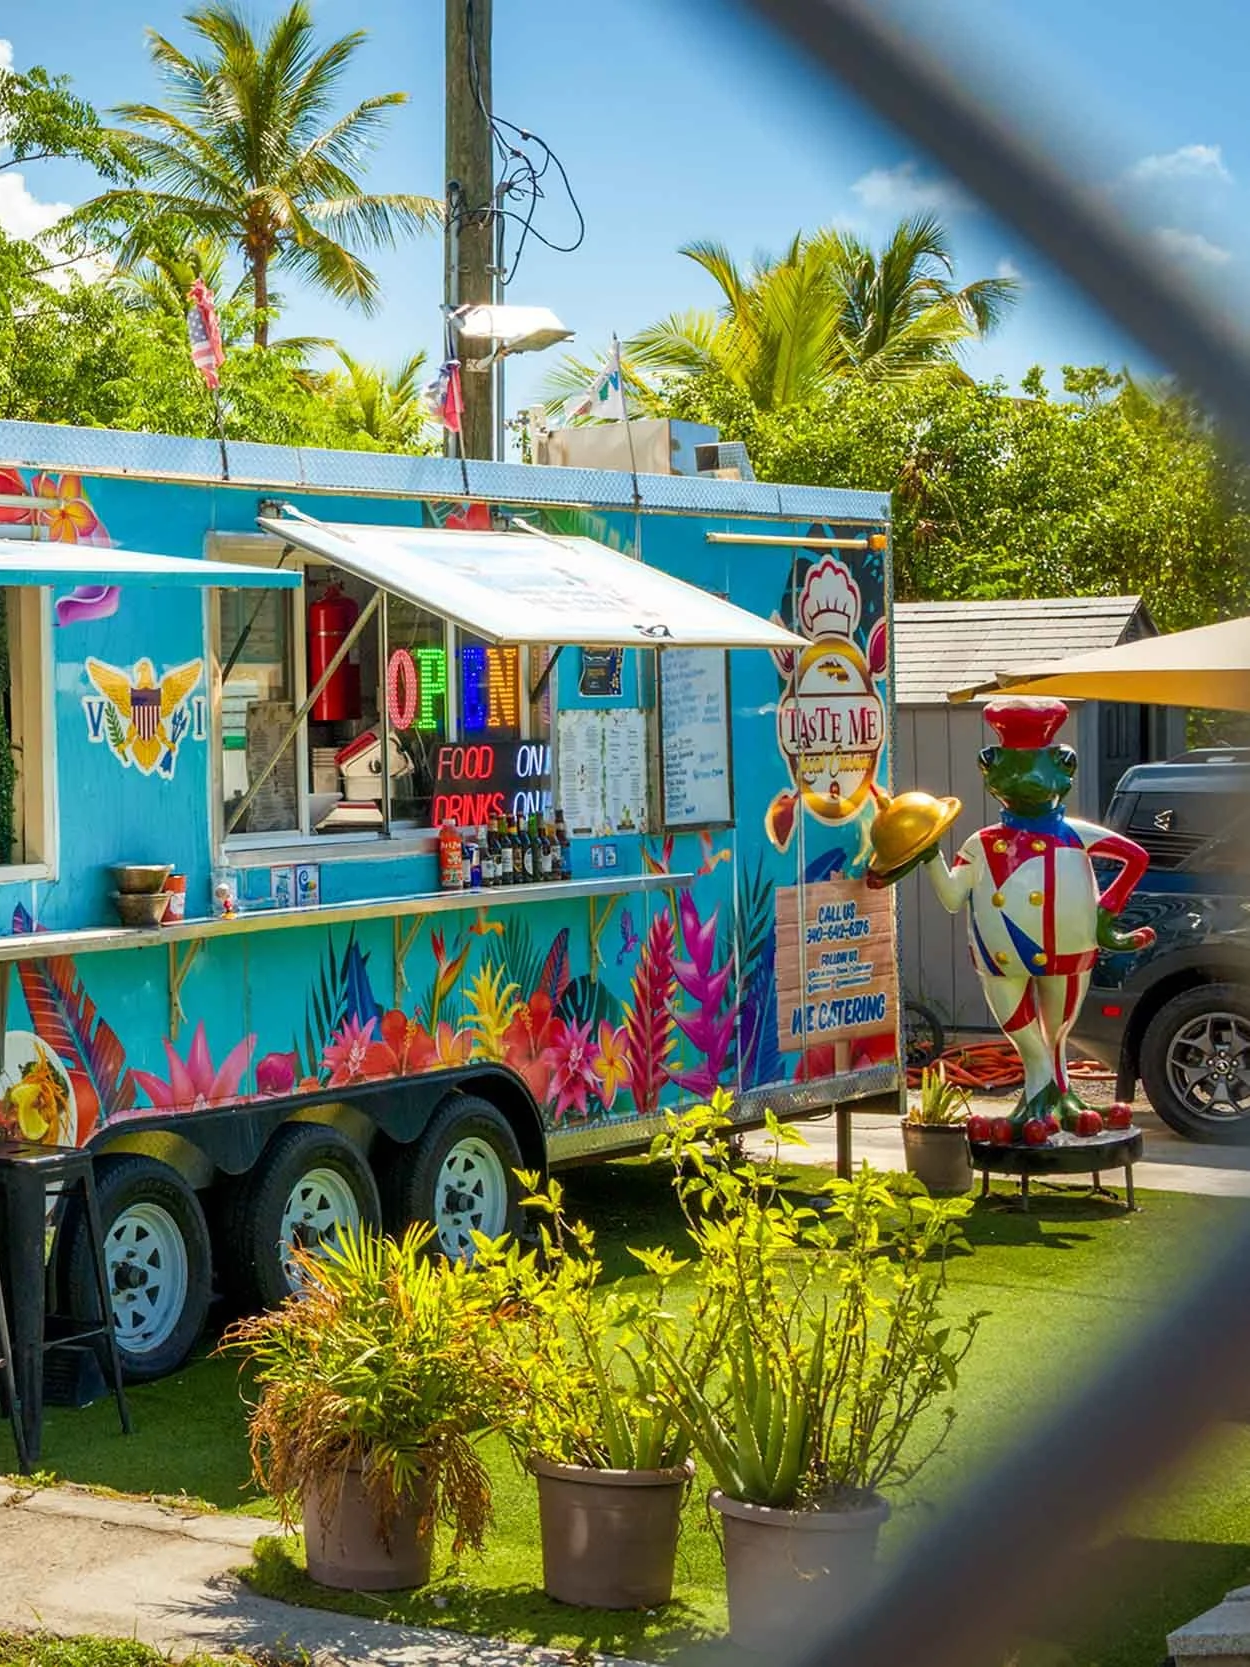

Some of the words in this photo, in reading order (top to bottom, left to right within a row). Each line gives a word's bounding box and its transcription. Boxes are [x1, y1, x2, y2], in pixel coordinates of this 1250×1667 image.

[387, 647, 517, 731] OPEN
[85, 700, 106, 738] V
[785, 707, 842, 749] TASTE
[848, 707, 878, 745] ME
[437, 745, 495, 780] FOOD
[432, 793, 505, 828] DRINKS
[818, 904, 842, 924] CALL
[843, 902, 856, 920] US
[821, 951, 848, 966] FOLLOW
[818, 994, 886, 1030] CATERING
